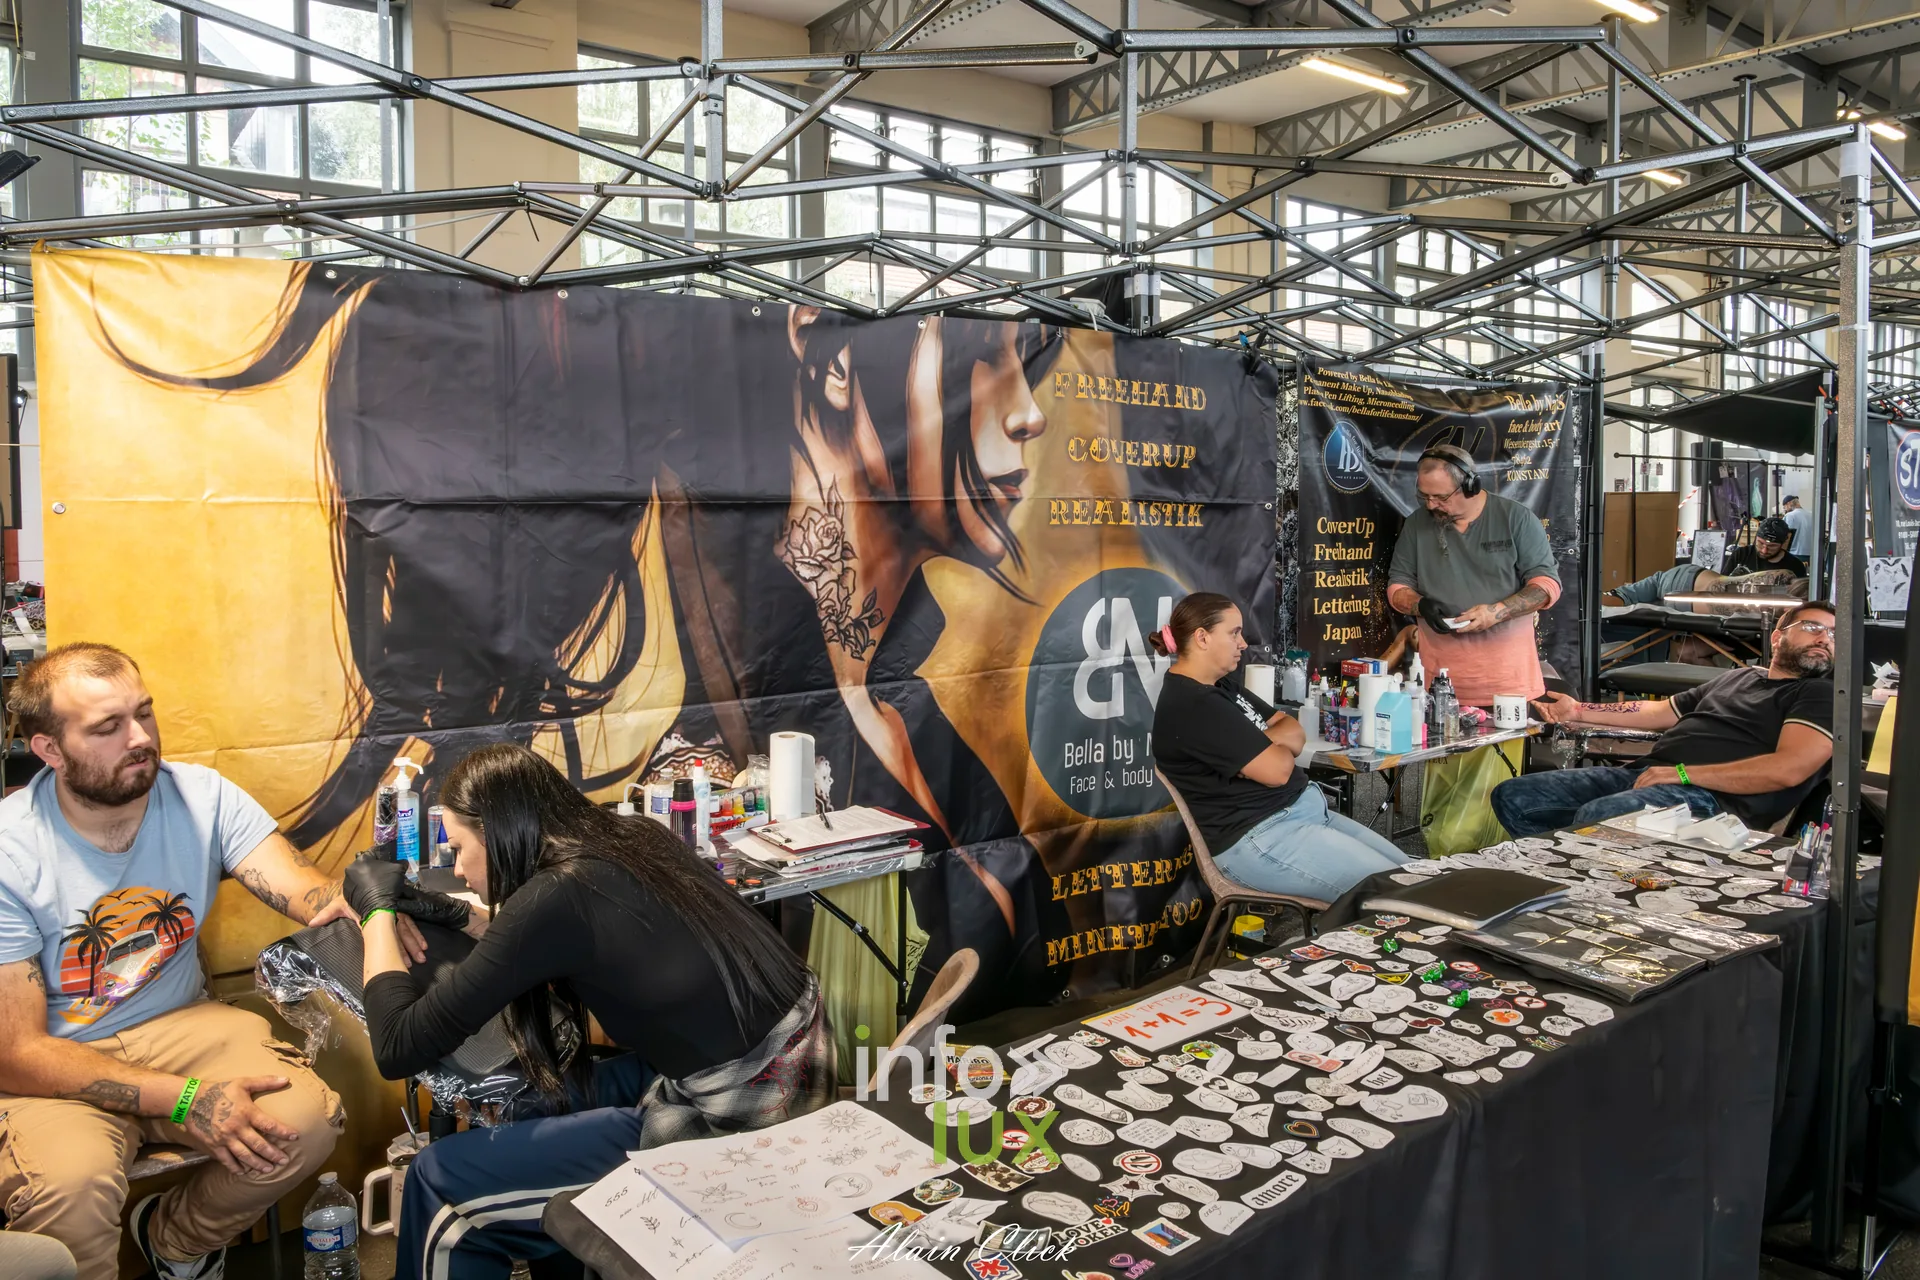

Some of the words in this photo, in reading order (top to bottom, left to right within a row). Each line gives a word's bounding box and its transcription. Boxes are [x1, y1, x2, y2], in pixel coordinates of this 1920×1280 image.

[1318, 367, 1348, 379] Powered
[1349, 371, 1358, 382] by
[1359, 374, 1376, 384] Bella
[1054, 371, 1207, 411] FREEHAND
[1324, 390, 1337, 400] Pen
[1338, 393, 1365, 405] Lifting,
[1341, 382, 1361, 392] Make
[1504, 392, 1533, 411] Bella
[1530, 394, 1544, 415] by
[1508, 419, 1523, 433] face
[1544, 420, 1561, 432] art
[1067, 435, 1197, 469] COVERUP
[1506, 468, 1549, 482] KONSTANZ
[1049, 499, 1205, 527] REALISTIK
[1316, 516, 1375, 538] CoverUp
[1314, 543, 1373, 561] Freihand
[1314, 567, 1370, 588] Realistik
[1313, 597, 1371, 618] Lettering
[1322, 623, 1362, 644] Japan
[1064, 736, 1105, 769] Bella
[1113, 734, 1134, 765] by
[1070, 775, 1096, 795] Face
[1104, 771, 1115, 789] &
[1122, 765, 1153, 788] body
[1101, 1011, 1136, 1027] MINI
[1136, 992, 1191, 1013] TATTOO
[1251, 1174, 1300, 1206] amore
[1054, 1219, 1106, 1242] LOVE
[1124, 1259, 1156, 1279] LOVE
